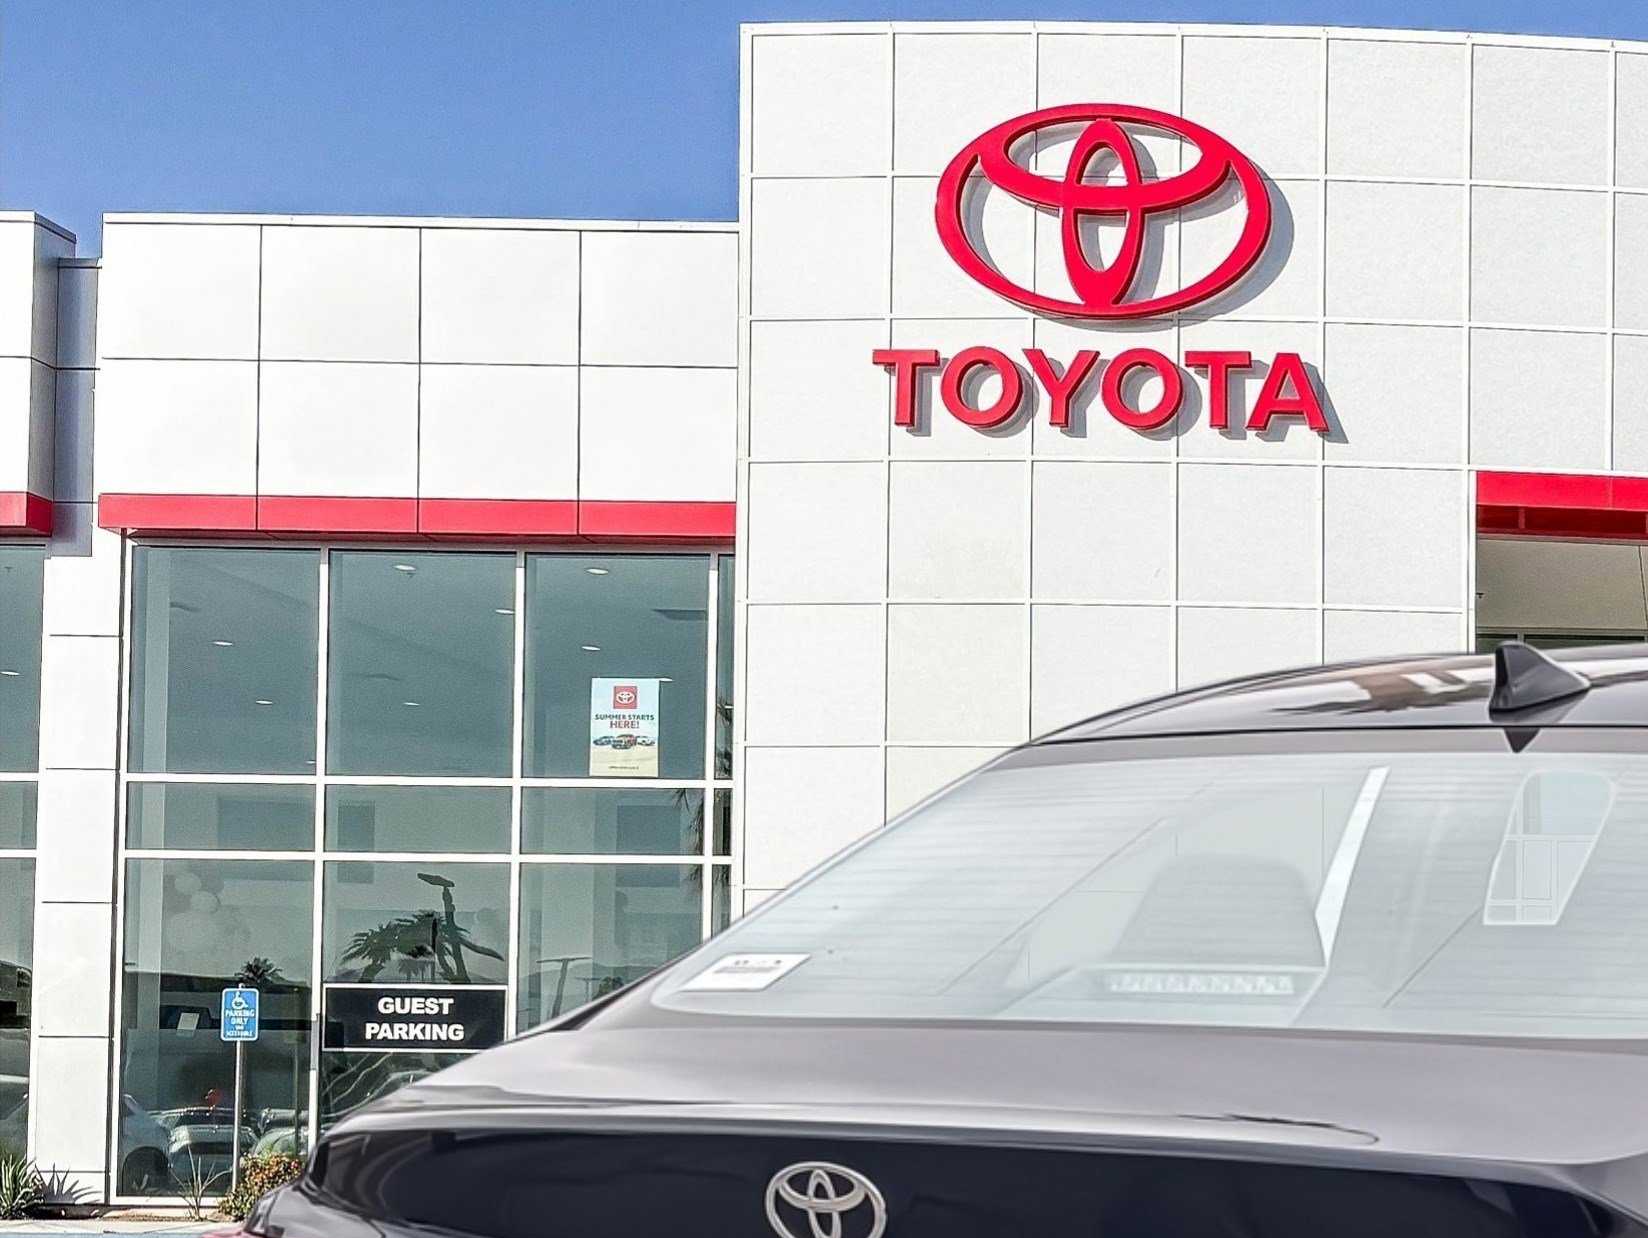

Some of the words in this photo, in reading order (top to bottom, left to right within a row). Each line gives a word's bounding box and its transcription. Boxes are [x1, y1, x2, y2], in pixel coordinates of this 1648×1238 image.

[872, 346, 1330, 432] TOYOTA
[609, 720, 640, 729] HERE!
[377, 997, 455, 1015] GUEST
[365, 1022, 465, 1041] PARKING
